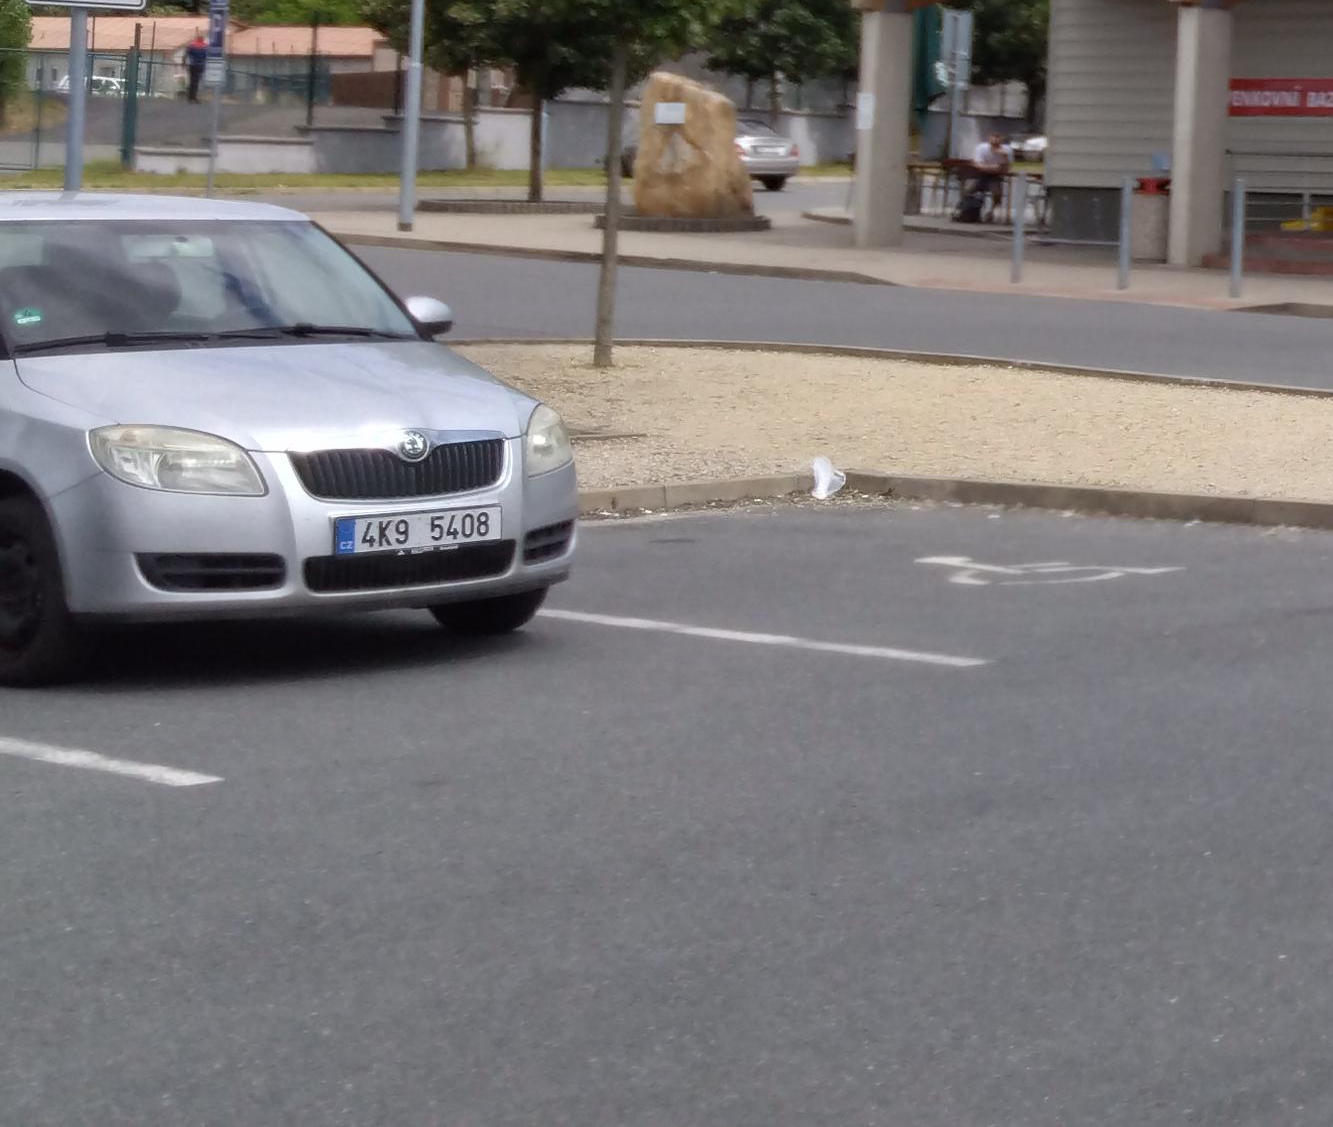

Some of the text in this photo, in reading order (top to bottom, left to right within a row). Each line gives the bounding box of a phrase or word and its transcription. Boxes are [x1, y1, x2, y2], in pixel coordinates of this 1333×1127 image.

[361, 511, 490, 548] 4K9 5408
[340, 540, 354, 550] CZ
